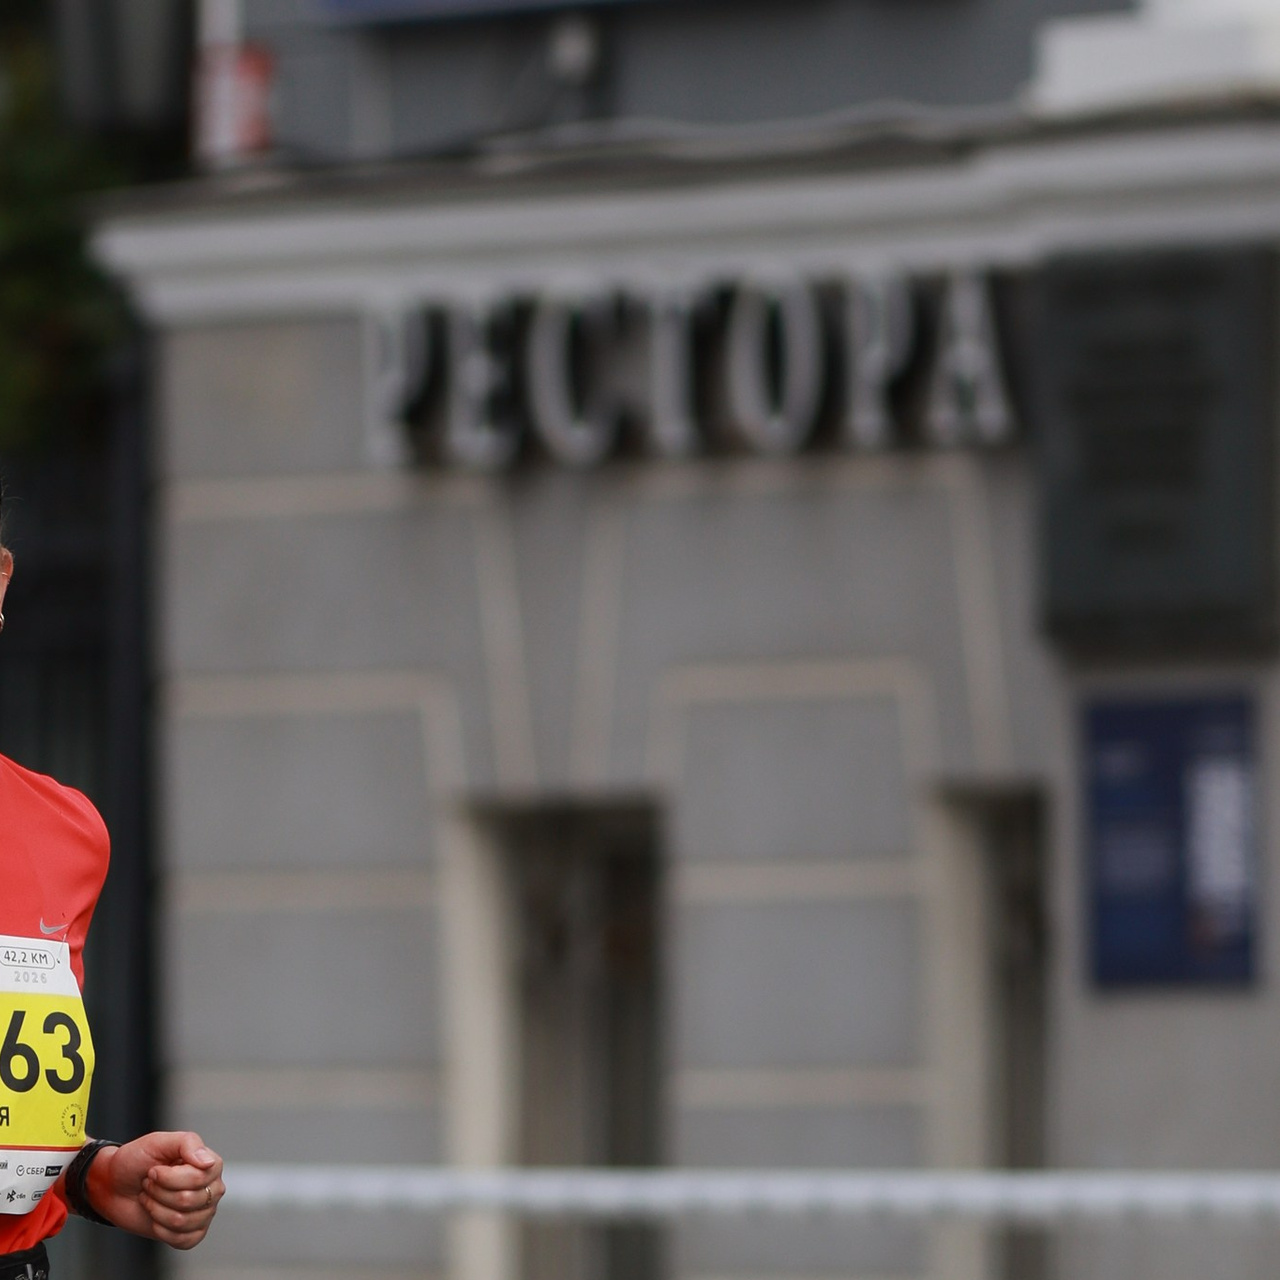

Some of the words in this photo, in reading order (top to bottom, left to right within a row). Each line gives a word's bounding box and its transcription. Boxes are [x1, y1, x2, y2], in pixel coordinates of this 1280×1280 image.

[4, 950, 27, 963] 42,2
[31, 952, 49, 965] КМ
[14, 970, 47, 983] 2026
[70, 1113, 76, 1127] 1
[26, 1167, 45, 1175] СБЕР
